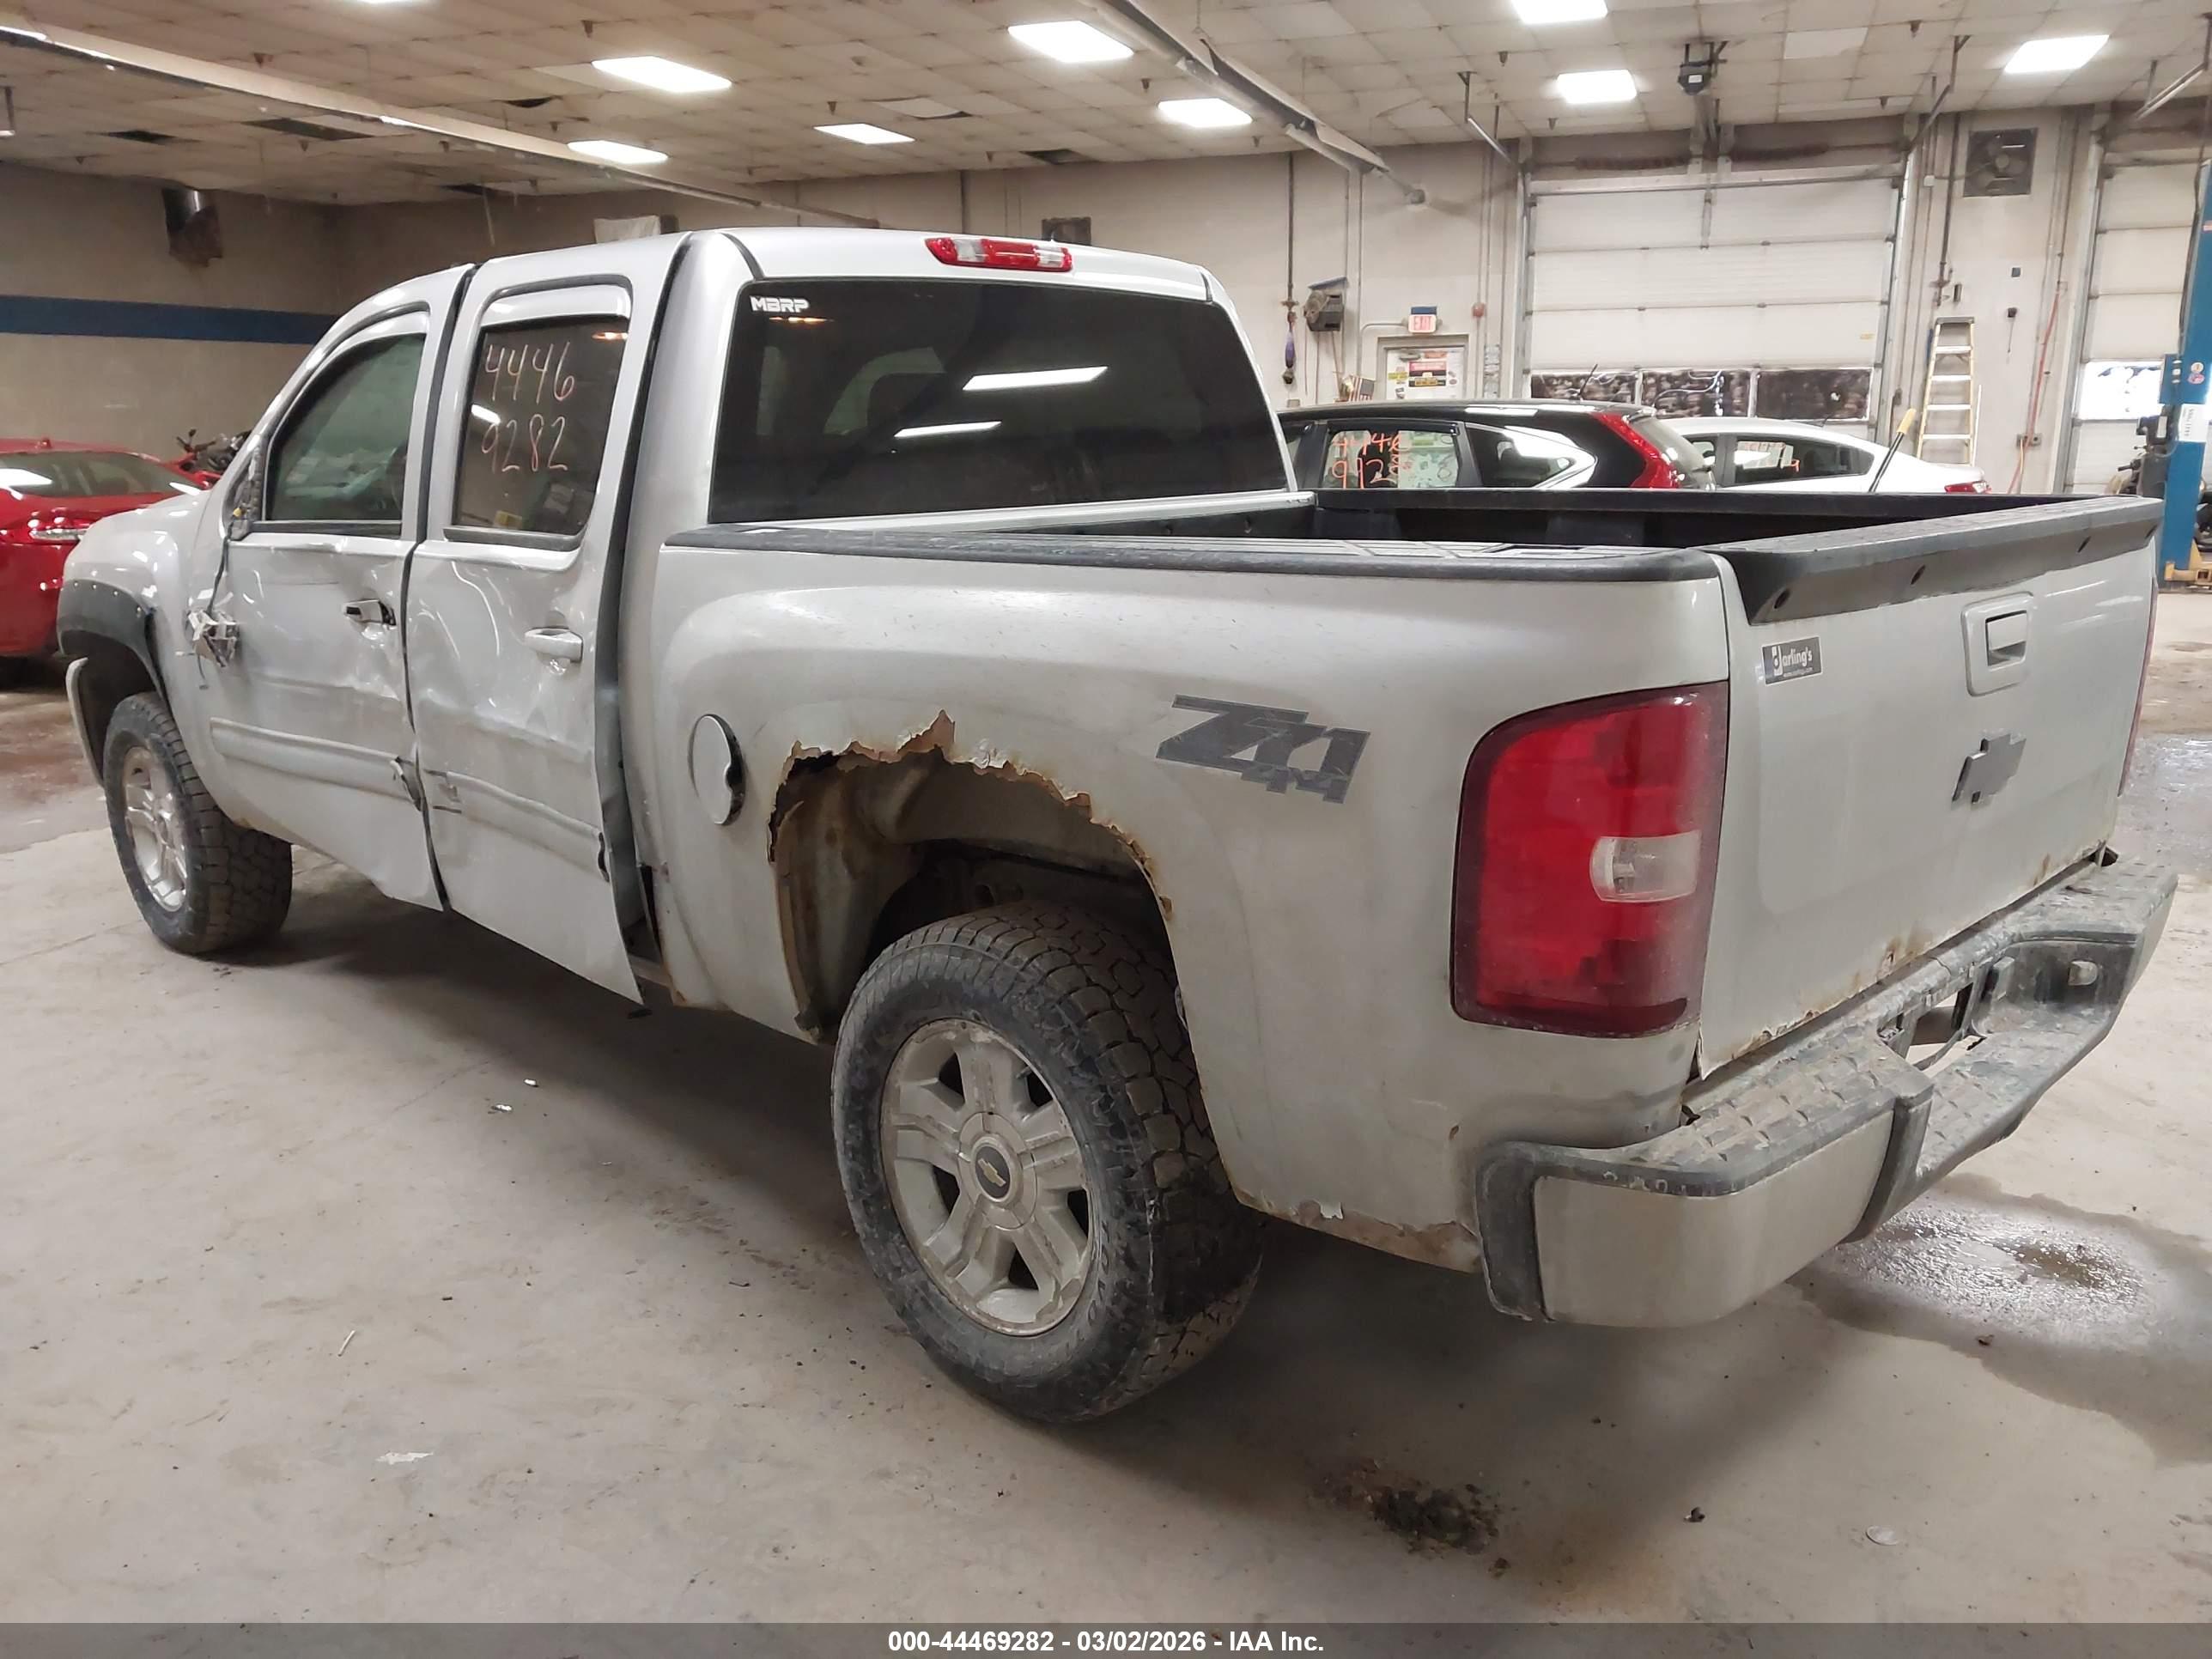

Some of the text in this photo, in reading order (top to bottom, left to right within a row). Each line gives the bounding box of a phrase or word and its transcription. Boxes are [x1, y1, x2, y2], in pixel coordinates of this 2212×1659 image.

[750, 295, 811, 313] MBRP
[484, 342, 575, 404] 4446
[481, 414, 568, 474] 9282
[1156, 694, 1371, 778] Z71
